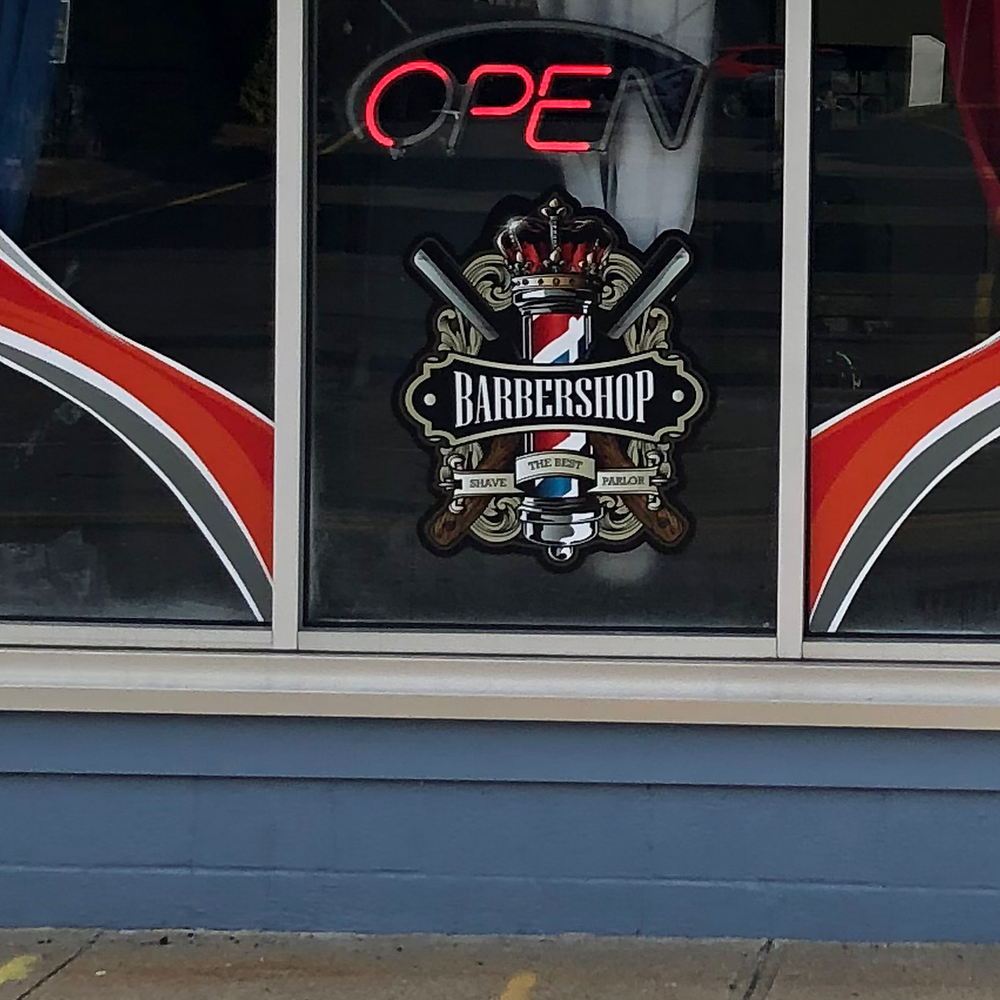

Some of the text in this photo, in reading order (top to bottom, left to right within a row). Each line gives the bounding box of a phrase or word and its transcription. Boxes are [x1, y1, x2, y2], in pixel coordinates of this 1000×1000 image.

[366, 60, 704, 154] OPEN
[453, 369, 655, 429] BARBERSHOP
[469, 475, 646, 488] SHAVE PARLOR
[527, 457, 584, 471] THE BEST
